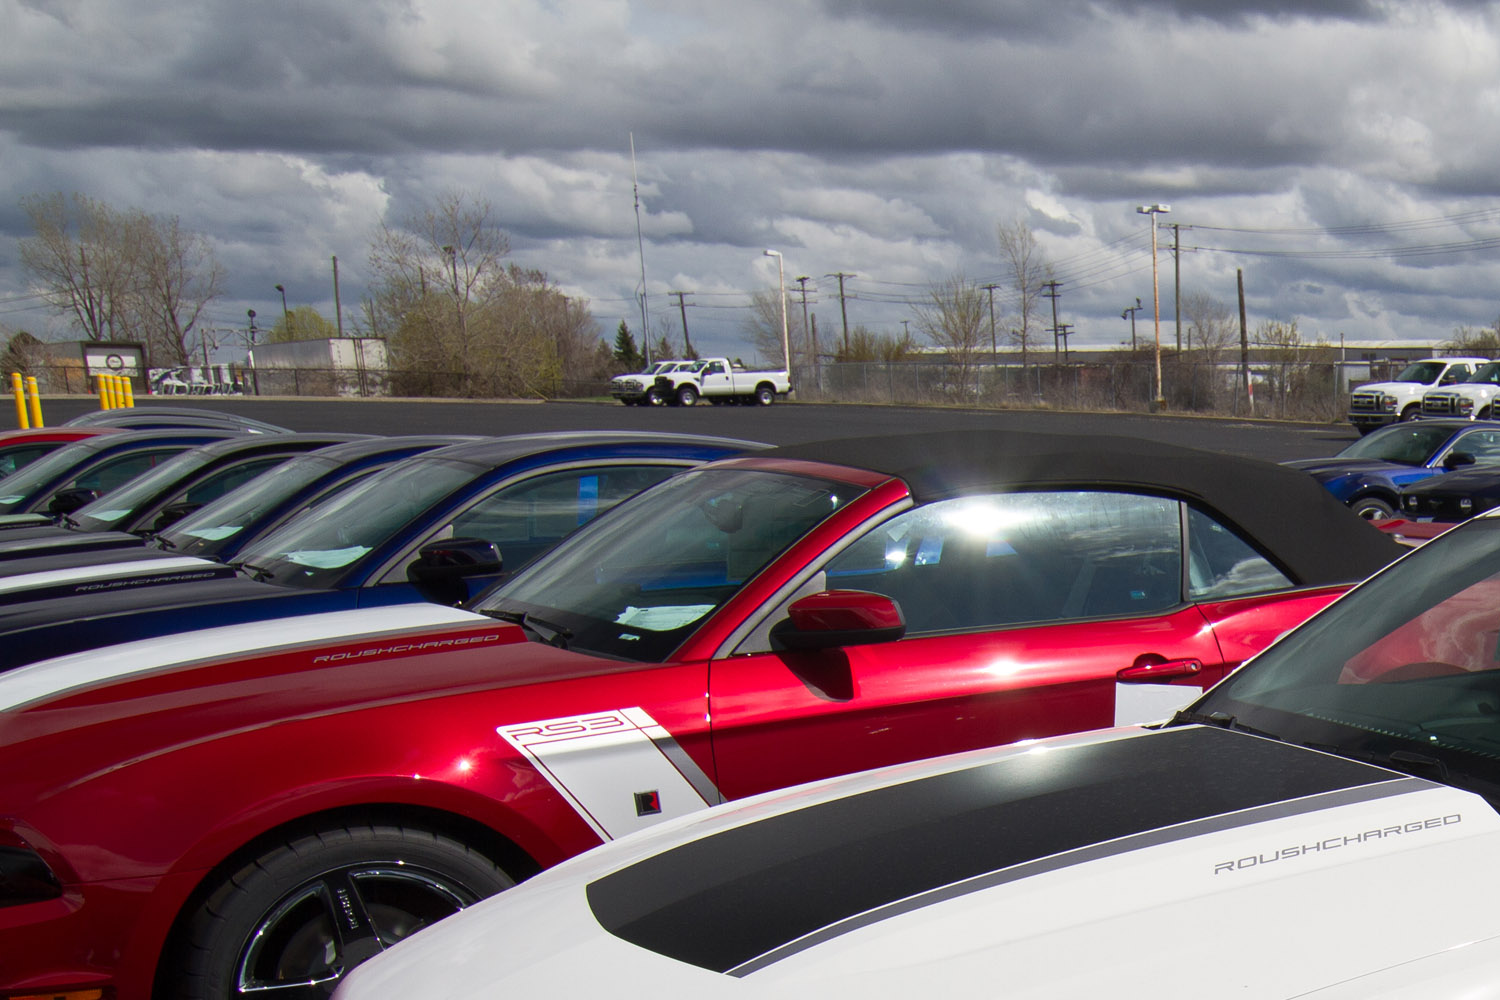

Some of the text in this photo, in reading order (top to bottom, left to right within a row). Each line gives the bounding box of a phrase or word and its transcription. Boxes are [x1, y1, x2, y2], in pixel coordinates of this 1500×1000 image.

[75, 572, 216, 592] ROUSHCHARGED
[312, 634, 500, 663] ROUSHCHARGED
[506, 715, 625, 742] RS3
[1213, 813, 1462, 875] ROUSHCHARGED
